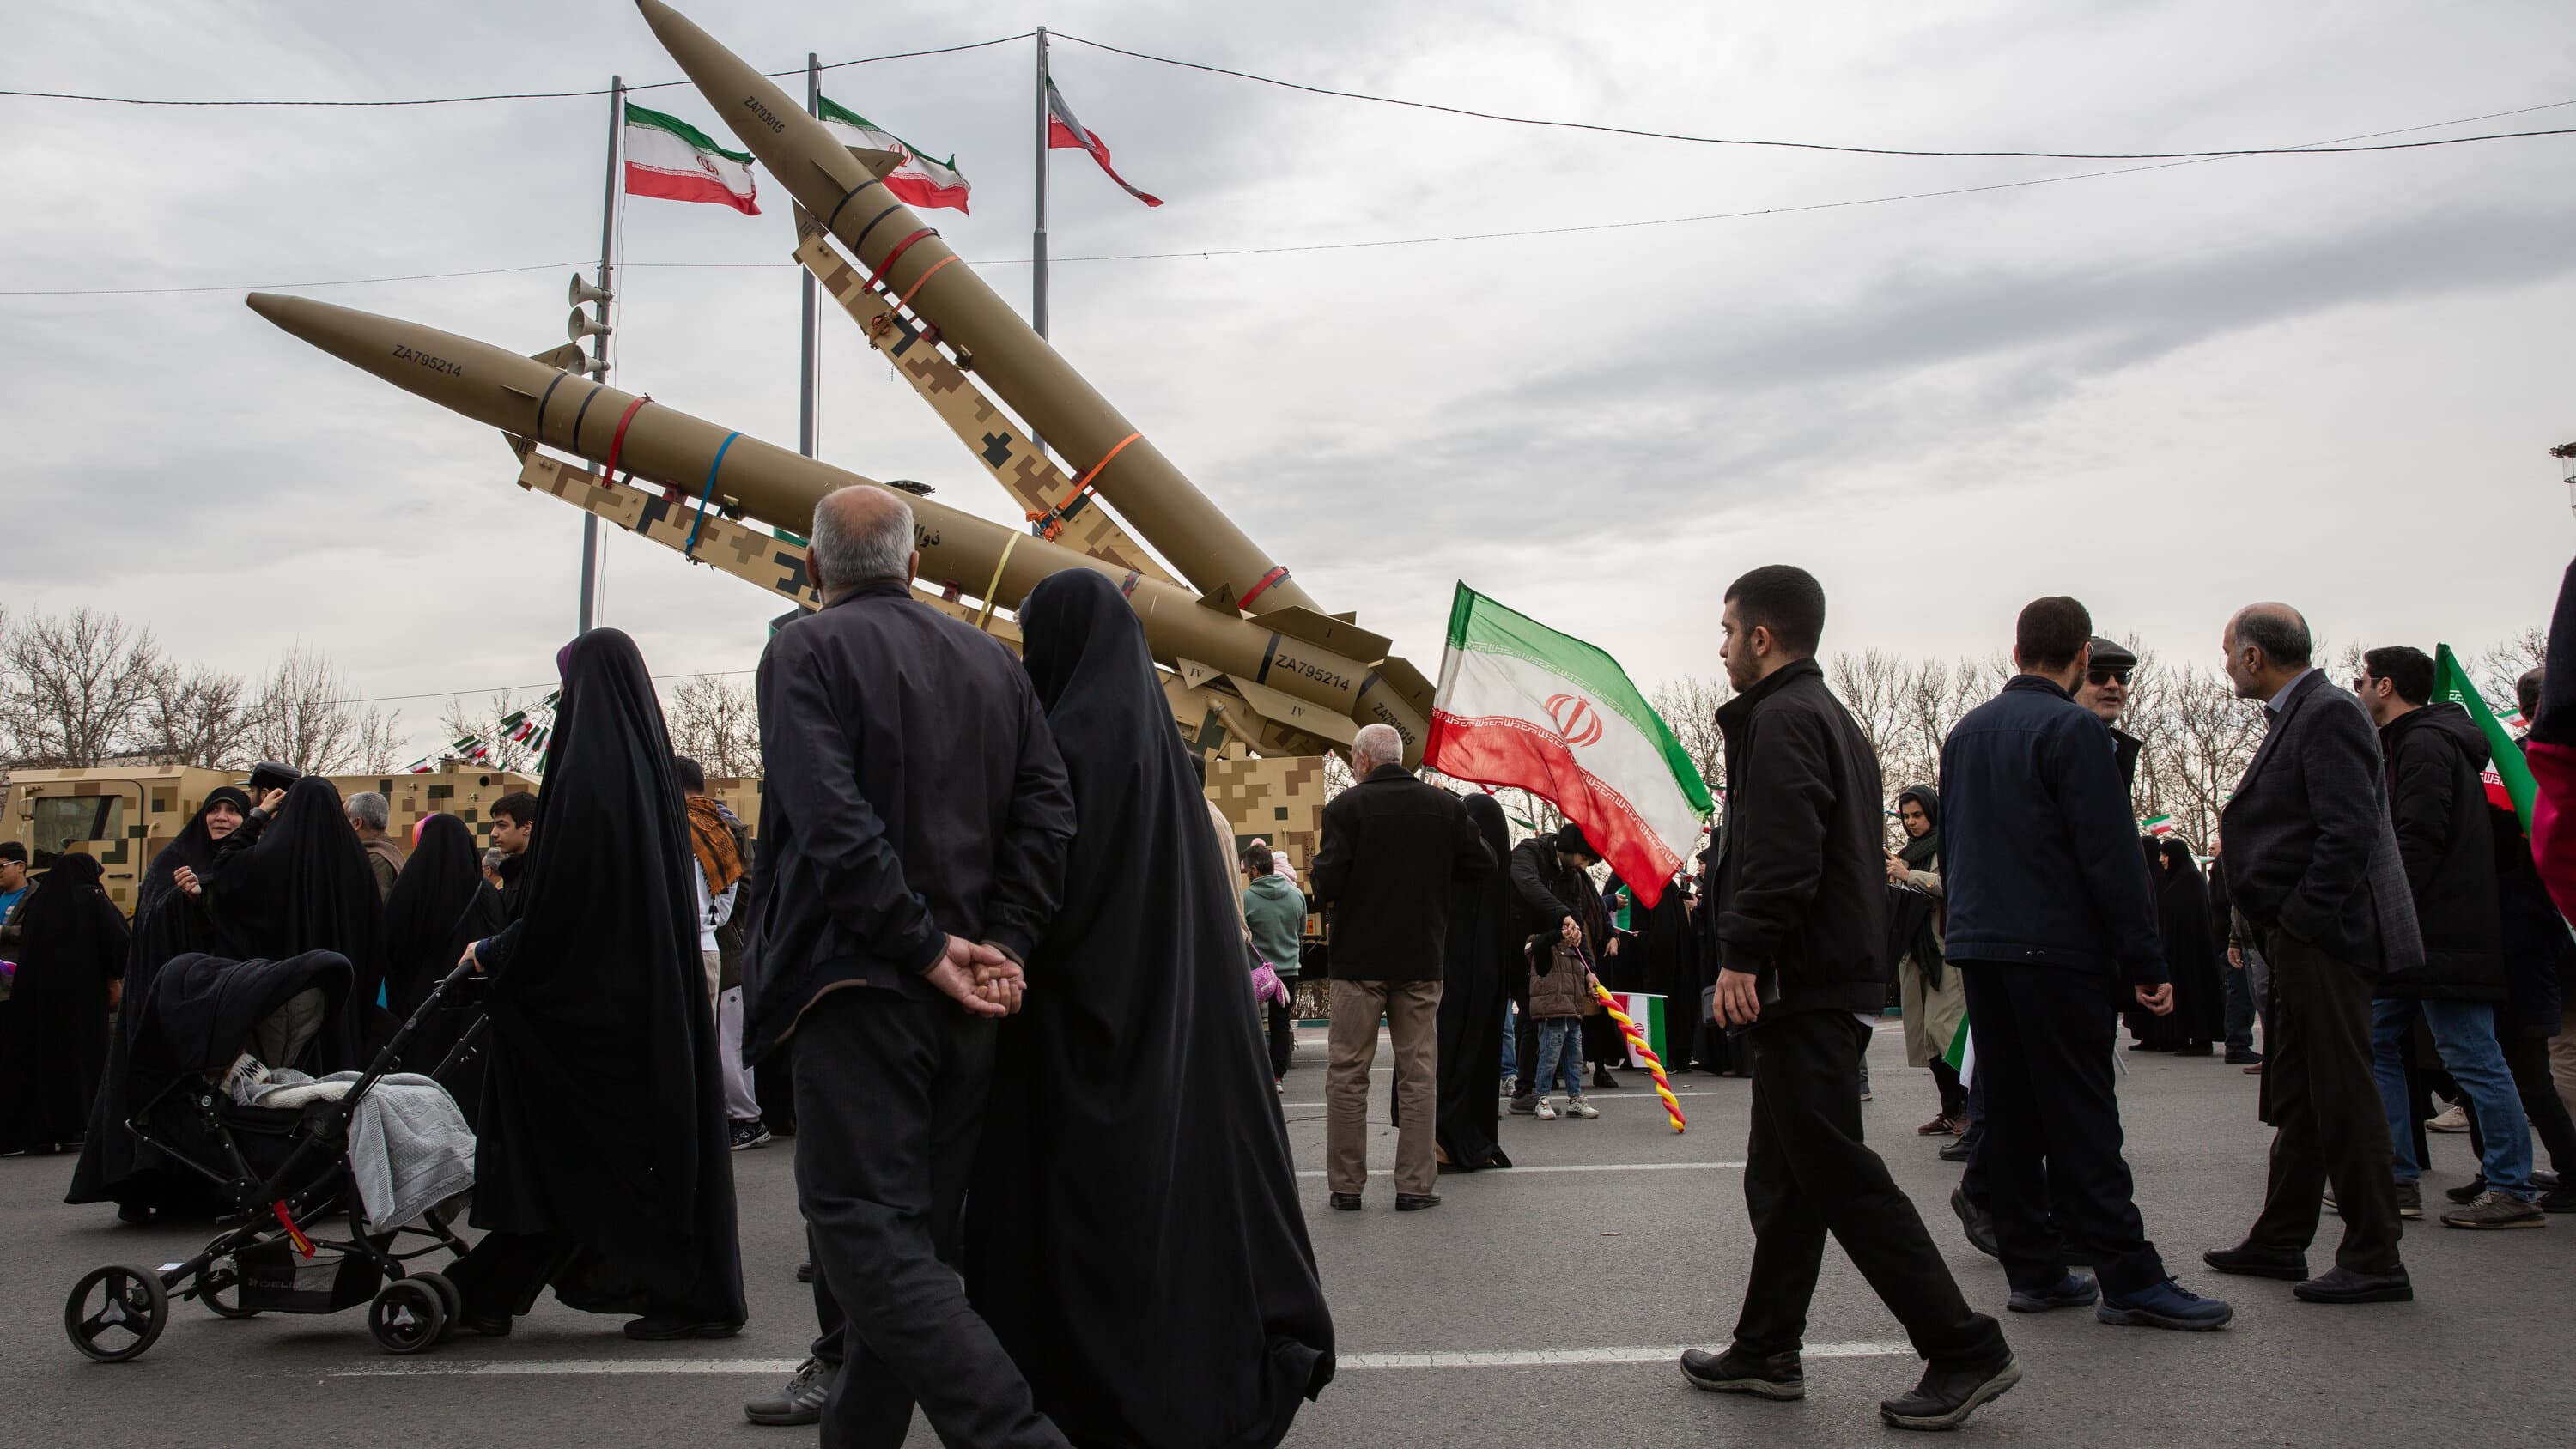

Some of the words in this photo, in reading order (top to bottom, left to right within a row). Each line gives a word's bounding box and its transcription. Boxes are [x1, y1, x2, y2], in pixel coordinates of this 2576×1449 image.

[744, 95, 786, 134] ZA793015
[392, 343, 462, 378] ZA795214
[1275, 654, 1350, 692] ZA795214
[1373, 702, 1416, 746] ZA793015
